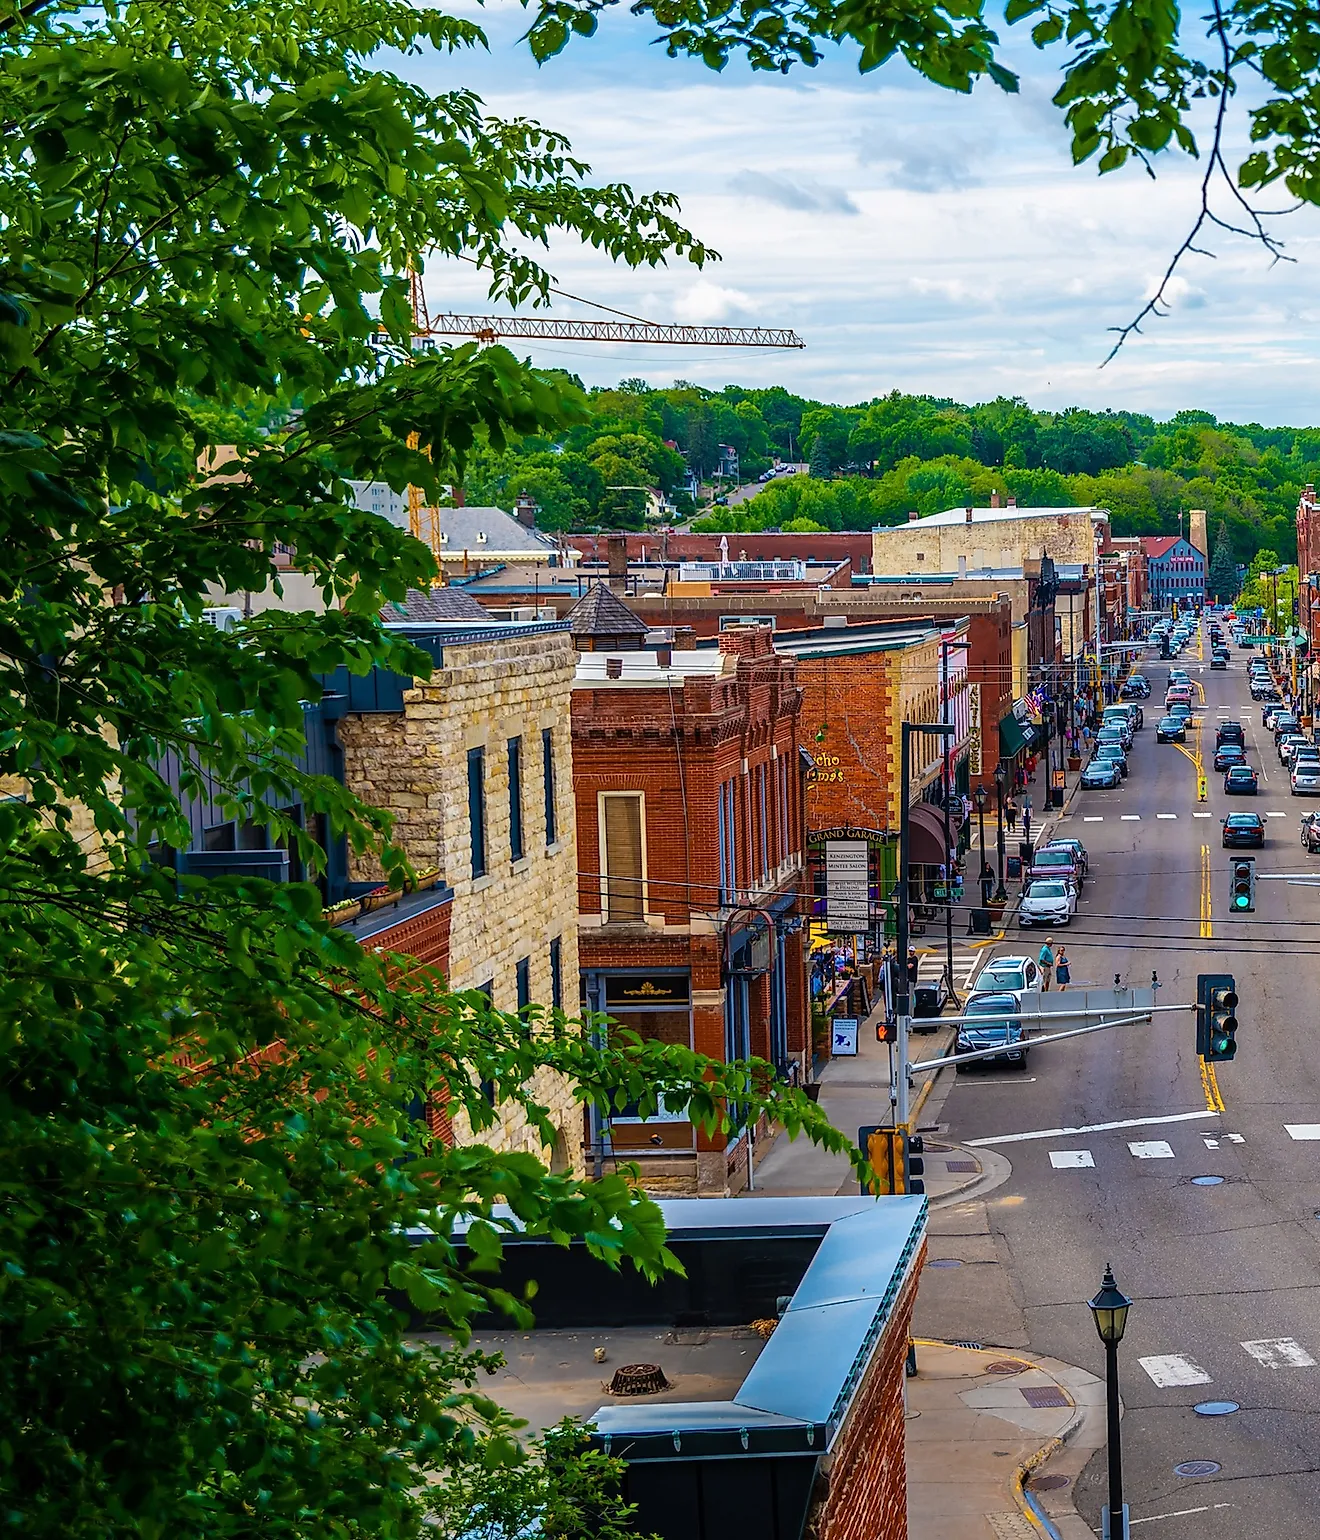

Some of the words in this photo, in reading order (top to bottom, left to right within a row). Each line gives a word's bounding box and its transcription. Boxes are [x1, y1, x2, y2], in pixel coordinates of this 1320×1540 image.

[969, 684, 980, 774] ANTIQUES
[808, 829, 844, 844] GRAND
[846, 829, 885, 843] GARAGE
